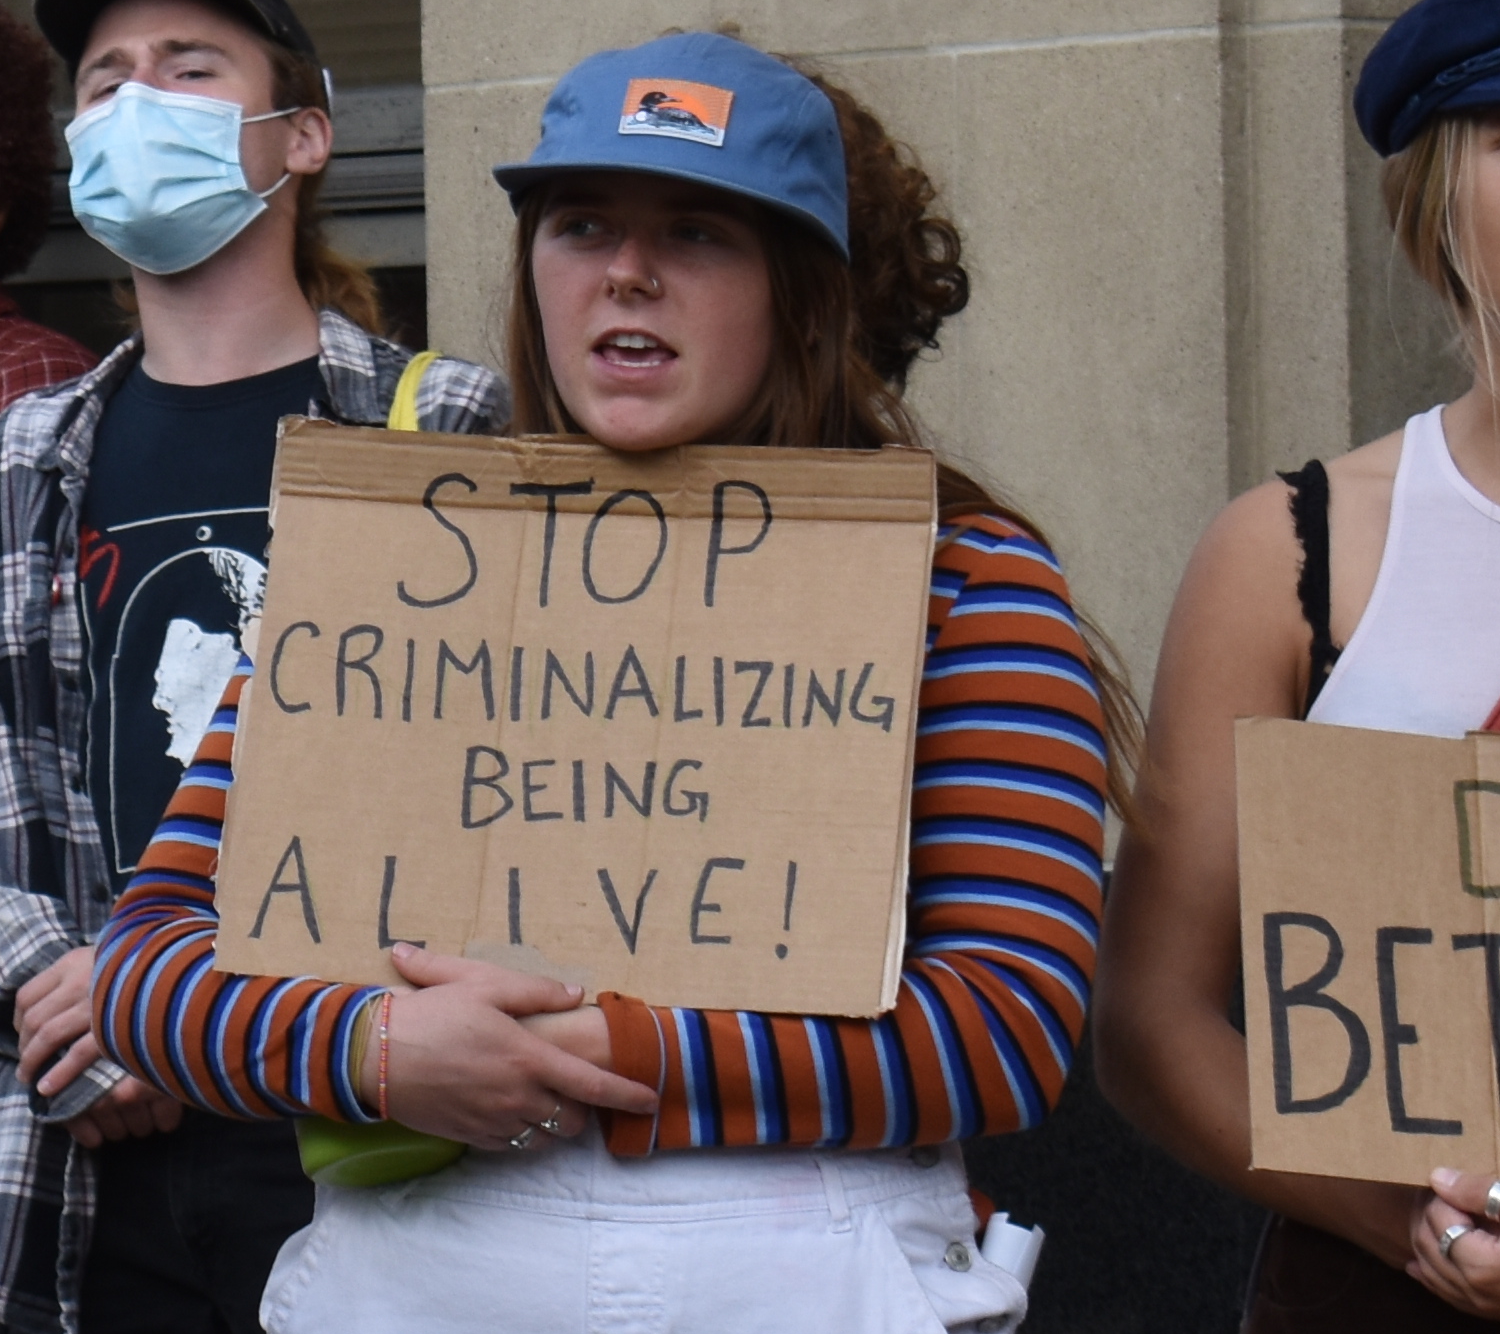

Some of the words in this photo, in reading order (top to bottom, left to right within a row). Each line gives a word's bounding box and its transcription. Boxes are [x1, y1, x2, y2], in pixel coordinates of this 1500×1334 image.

[397, 473, 773, 608] STOP
[269, 620, 895, 733] CRIMINALIZING
[460, 745, 710, 829] BEING
